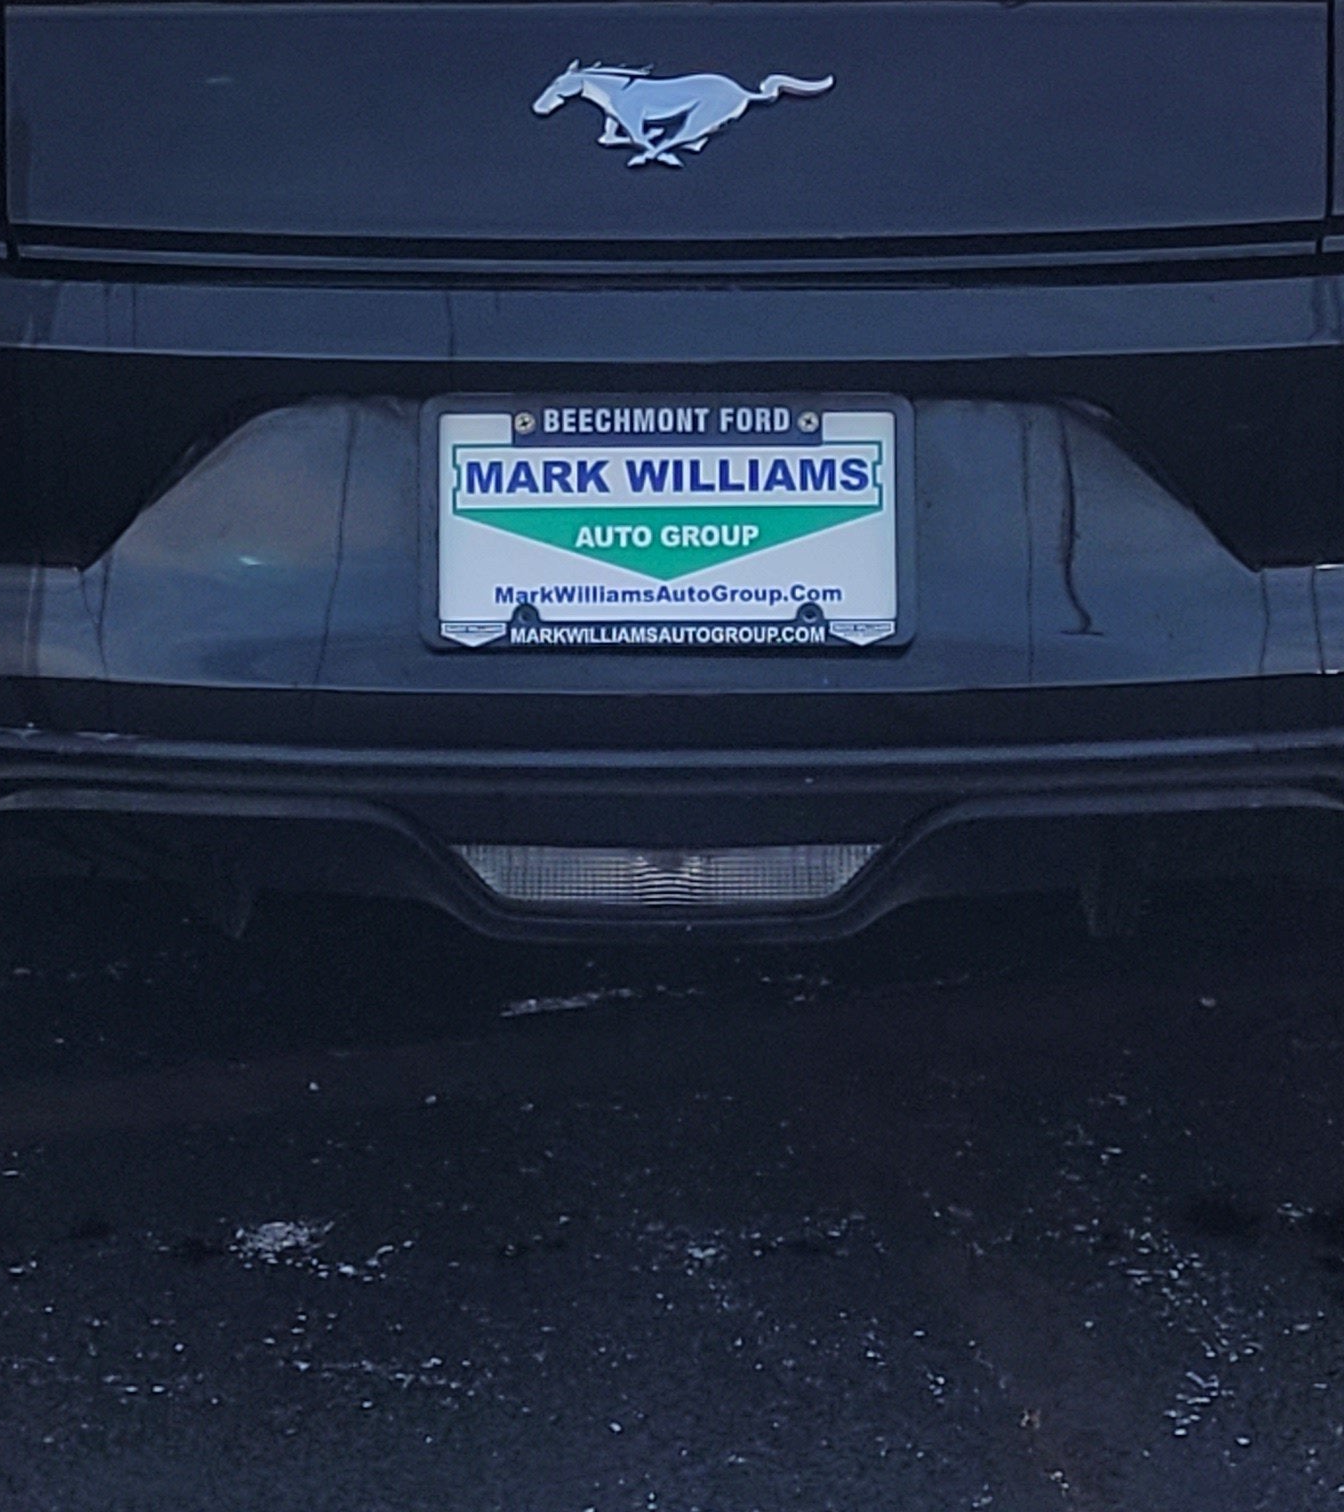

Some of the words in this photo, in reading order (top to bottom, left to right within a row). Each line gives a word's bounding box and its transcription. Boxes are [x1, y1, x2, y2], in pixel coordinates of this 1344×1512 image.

[542, 407, 710, 434] BEECHMONT
[719, 406, 791, 433] FORD
[465, 459, 611, 494] MARK
[625, 458, 869, 493] WILLIAMS
[575, 524, 653, 549] AUTO
[660, 523, 759, 548] GROUP
[494, 584, 843, 607] MarkWilliamsAutoGroup.Com
[509, 625, 827, 644] MARKWILLIAMSAUTOGROUP.COM
